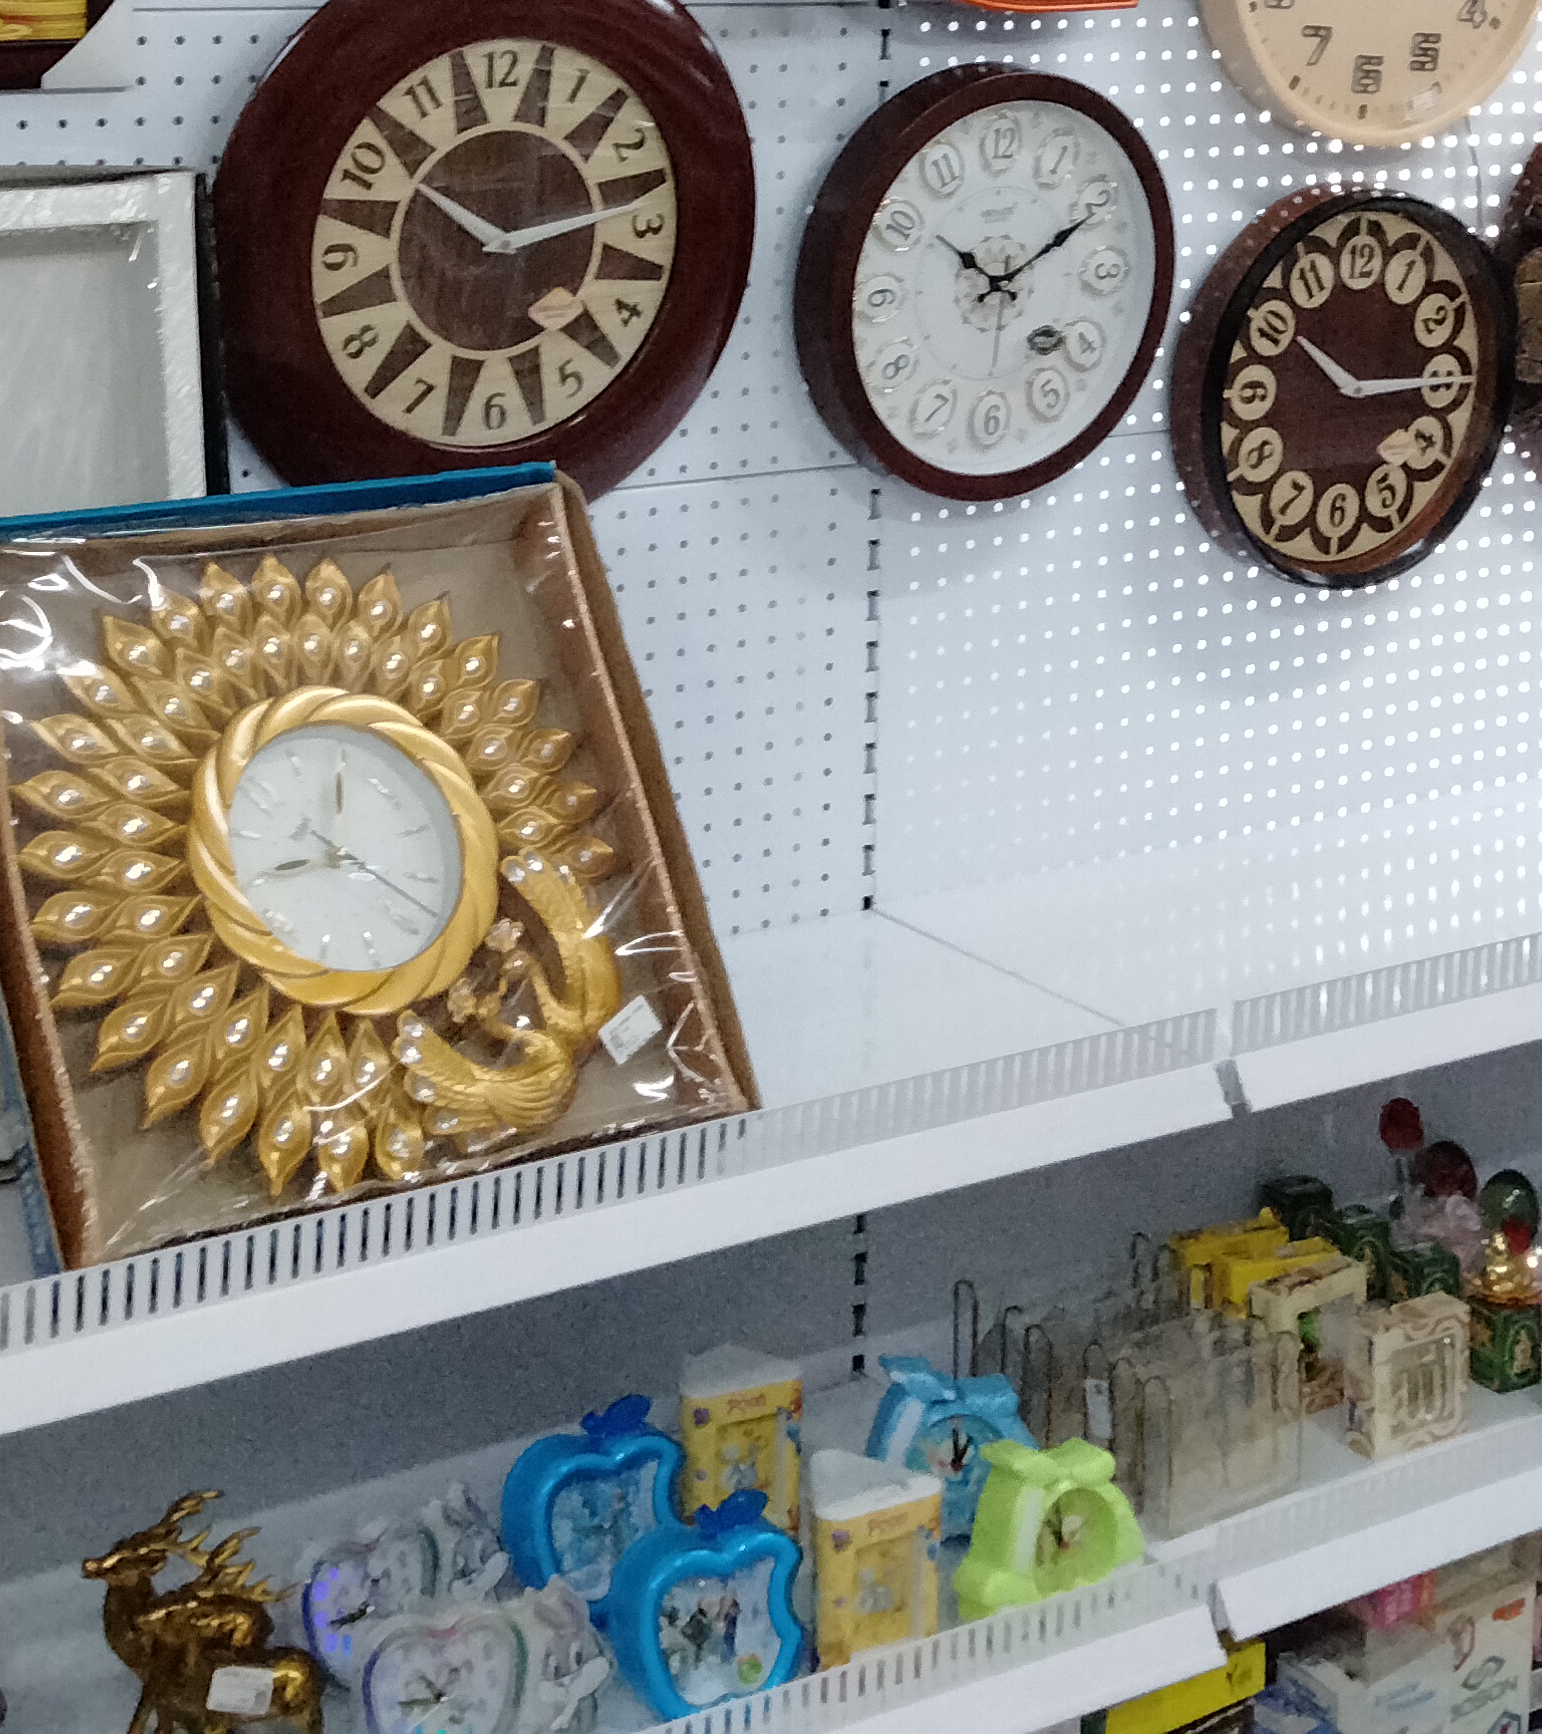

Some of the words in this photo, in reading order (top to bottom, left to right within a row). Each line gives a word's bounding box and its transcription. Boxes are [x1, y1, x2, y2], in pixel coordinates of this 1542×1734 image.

[1301, 25, 1333, 66] 7
[1409, 32, 1441, 71] 5
[483, 50, 519, 89] 12
[1352, 55, 1384, 94] 6
[403, 74, 444, 119] 11
[566, 69, 589, 104] 1
[612, 127, 647, 162] 2
[992, 128, 1015, 160] 12
[1049, 146, 1068, 175] 1
[341, 141, 386, 191] 10
[931, 154, 957, 189] 11
[1085, 189, 1112, 218] 2
[632, 213, 665, 240] 3
[886, 211, 915, 240] 10
[321, 242, 358, 272] 9
[1094, 262, 1118, 280] 3
[1349, 242, 1373, 279] 12
[1297, 261, 1325, 301] 11
[1396, 260, 1415, 293] 1
[614, 297, 644, 327] 4
[867, 289, 895, 308] 9
[1258, 310, 1288, 346] 10
[1421, 305, 1448, 334] 2
[342, 324, 379, 359] 8
[1079, 336, 1097, 356] 4
[557, 359, 584, 398] 5
[881, 353, 910, 379] 8
[403, 378, 436, 415] 7
[925, 393, 949, 423] 7
[1040, 378, 1060, 408] 5
[1239, 382, 1266, 405] 9
[483, 392, 507, 431] 6
[983, 405, 1000, 436] 6
[1247, 442, 1272, 466] 8
[1280, 481, 1305, 514] 7
[1378, 474, 1396, 507] 5
[1330, 493, 1345, 528] 6
